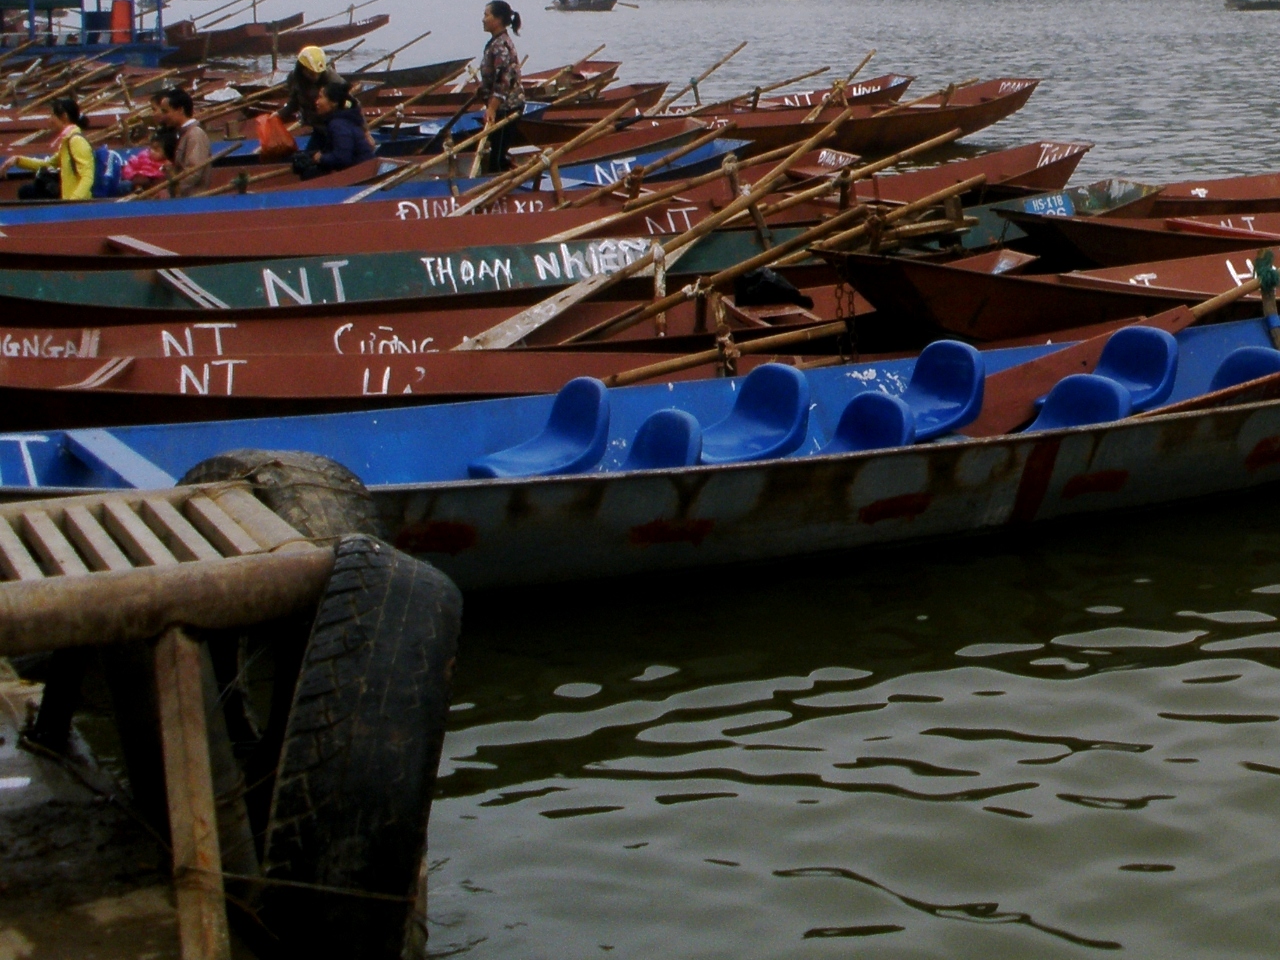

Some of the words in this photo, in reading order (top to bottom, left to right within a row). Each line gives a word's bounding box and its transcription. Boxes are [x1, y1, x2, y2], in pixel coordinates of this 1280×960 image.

[161, 323, 238, 357] NT
[180, 359, 248, 396] NT
[0, 434, 50, 487] T
